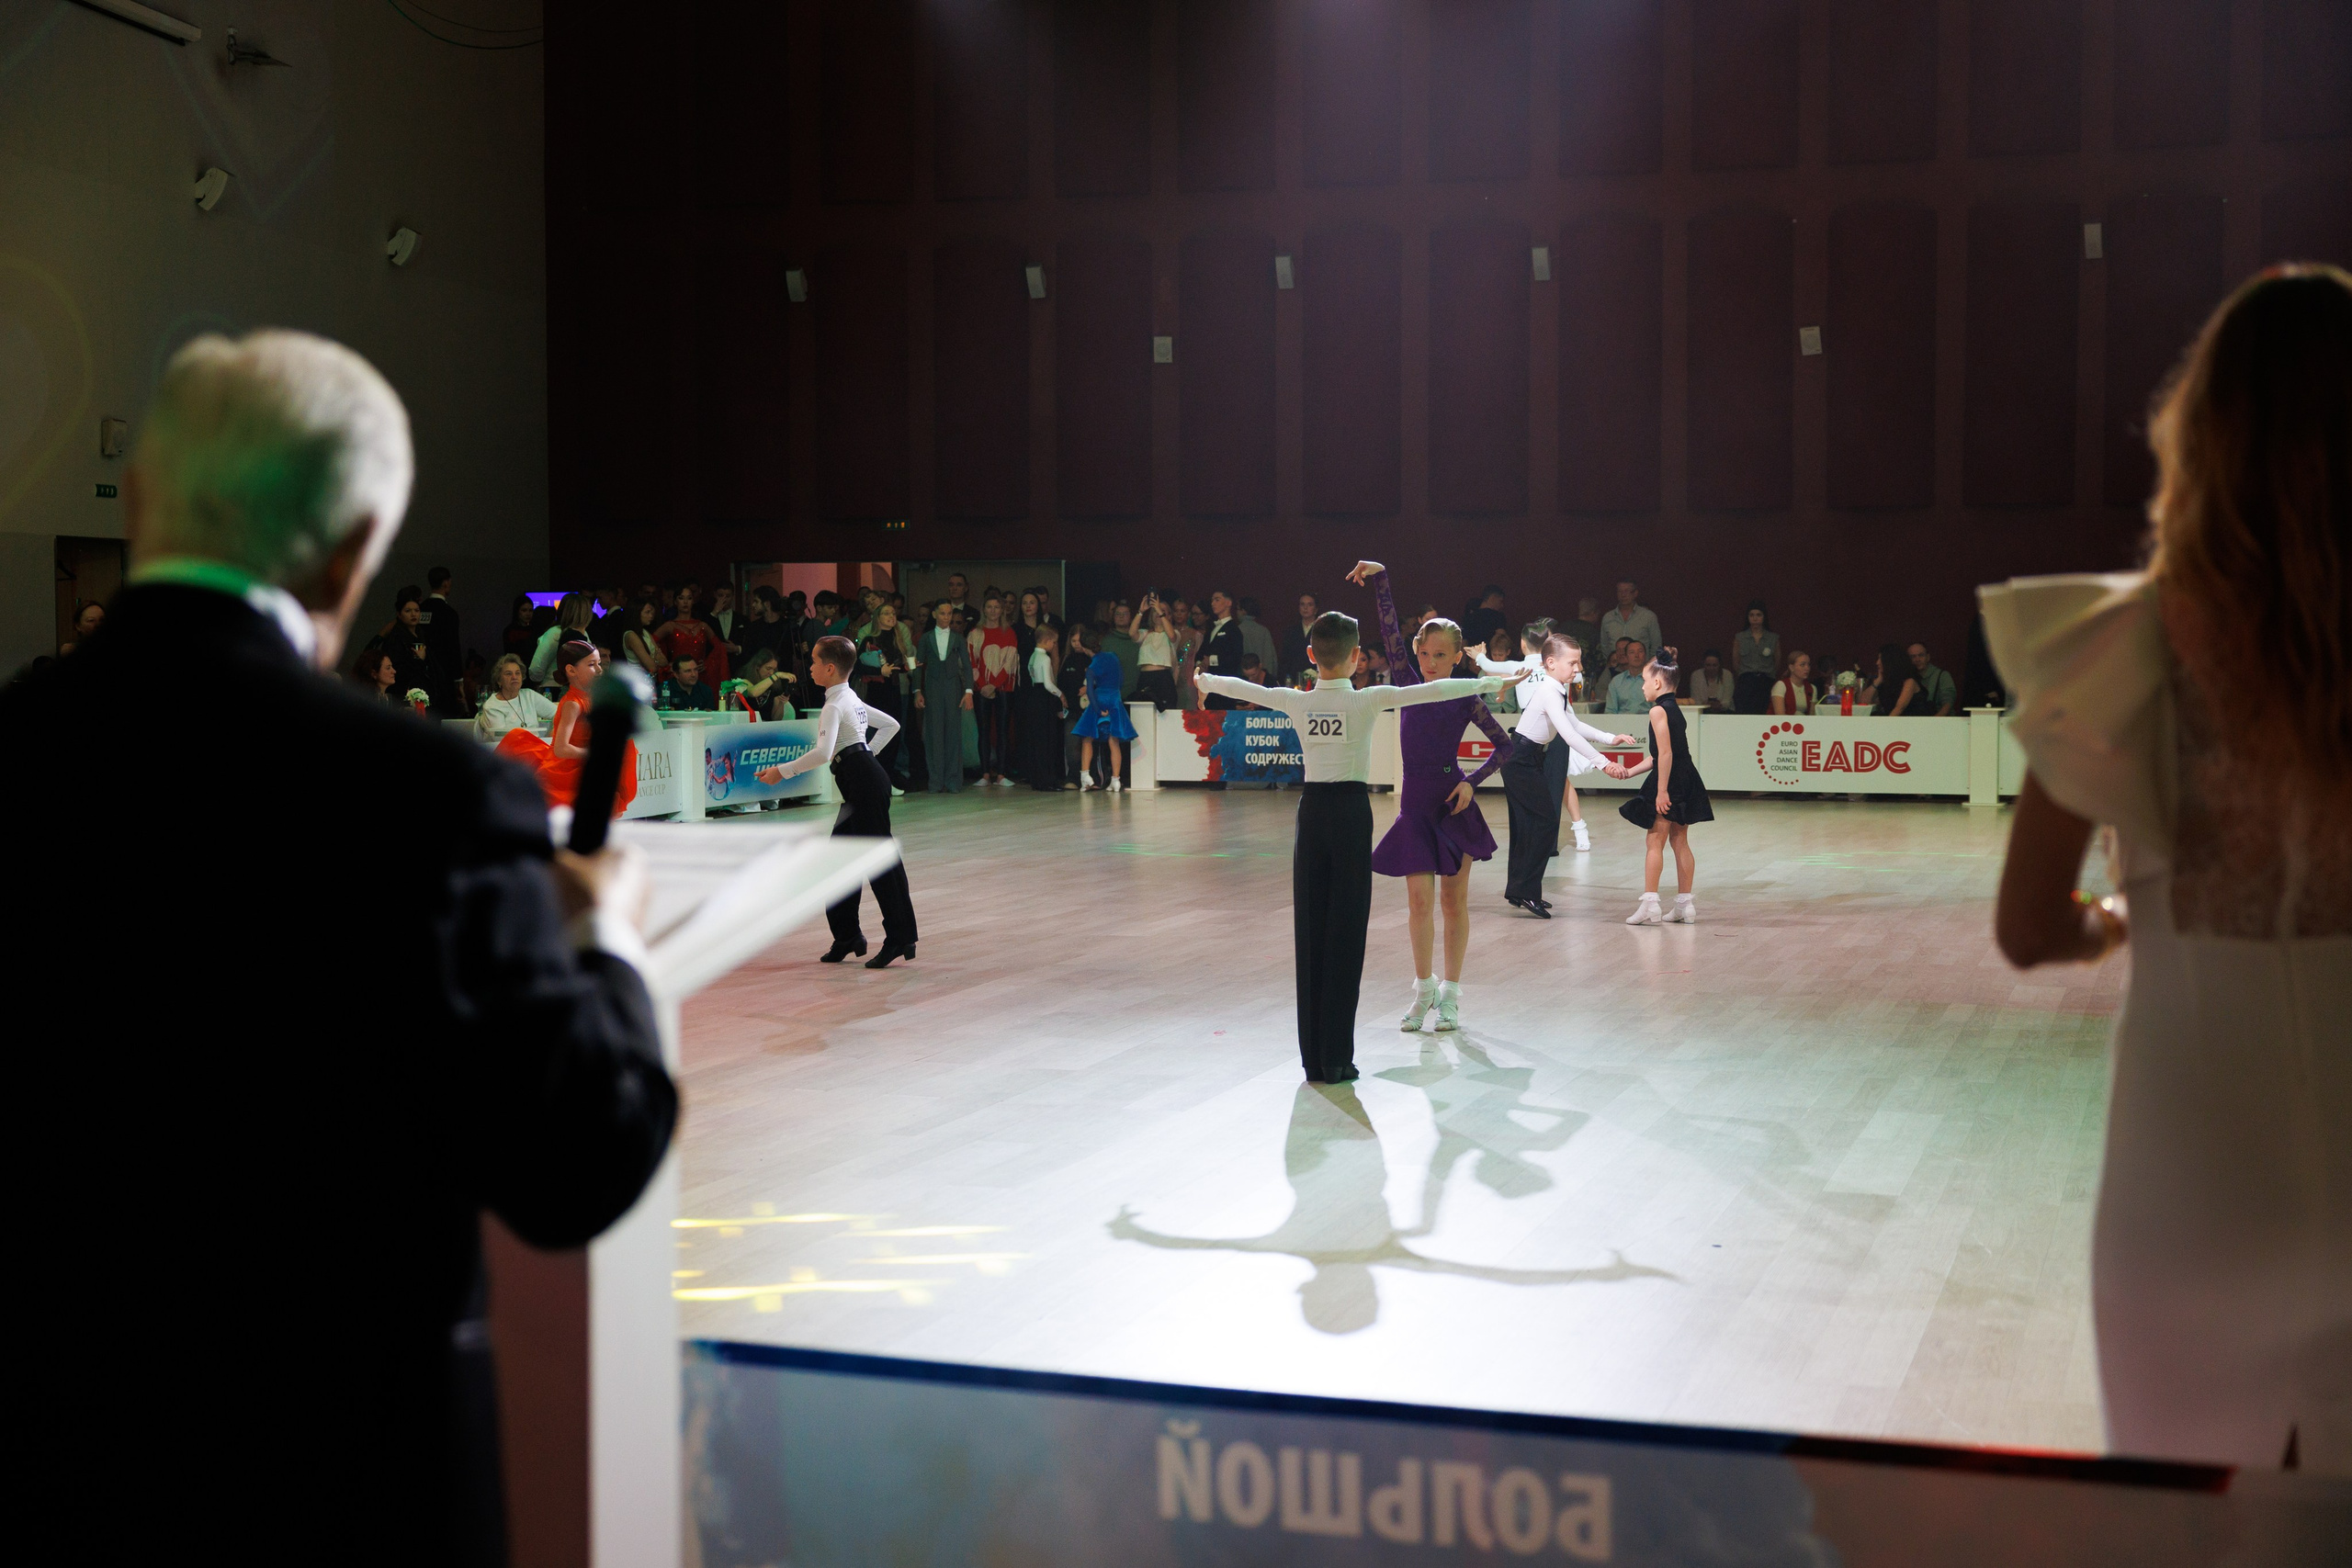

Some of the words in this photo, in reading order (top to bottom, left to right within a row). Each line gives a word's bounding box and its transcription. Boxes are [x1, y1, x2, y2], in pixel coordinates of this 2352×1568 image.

[1246, 717, 1295, 728] БОЛЬШО
[1308, 719, 1342, 736] 202
[1246, 735, 1280, 746] КУБОК
[1245, 753, 1305, 766] СОДРУЖЕСТ
[1802, 740, 1912, 773] EADC
[638, 751, 673, 781] IARA
[637, 785, 653, 797] ANCE
[654, 784, 666, 795] CUP
